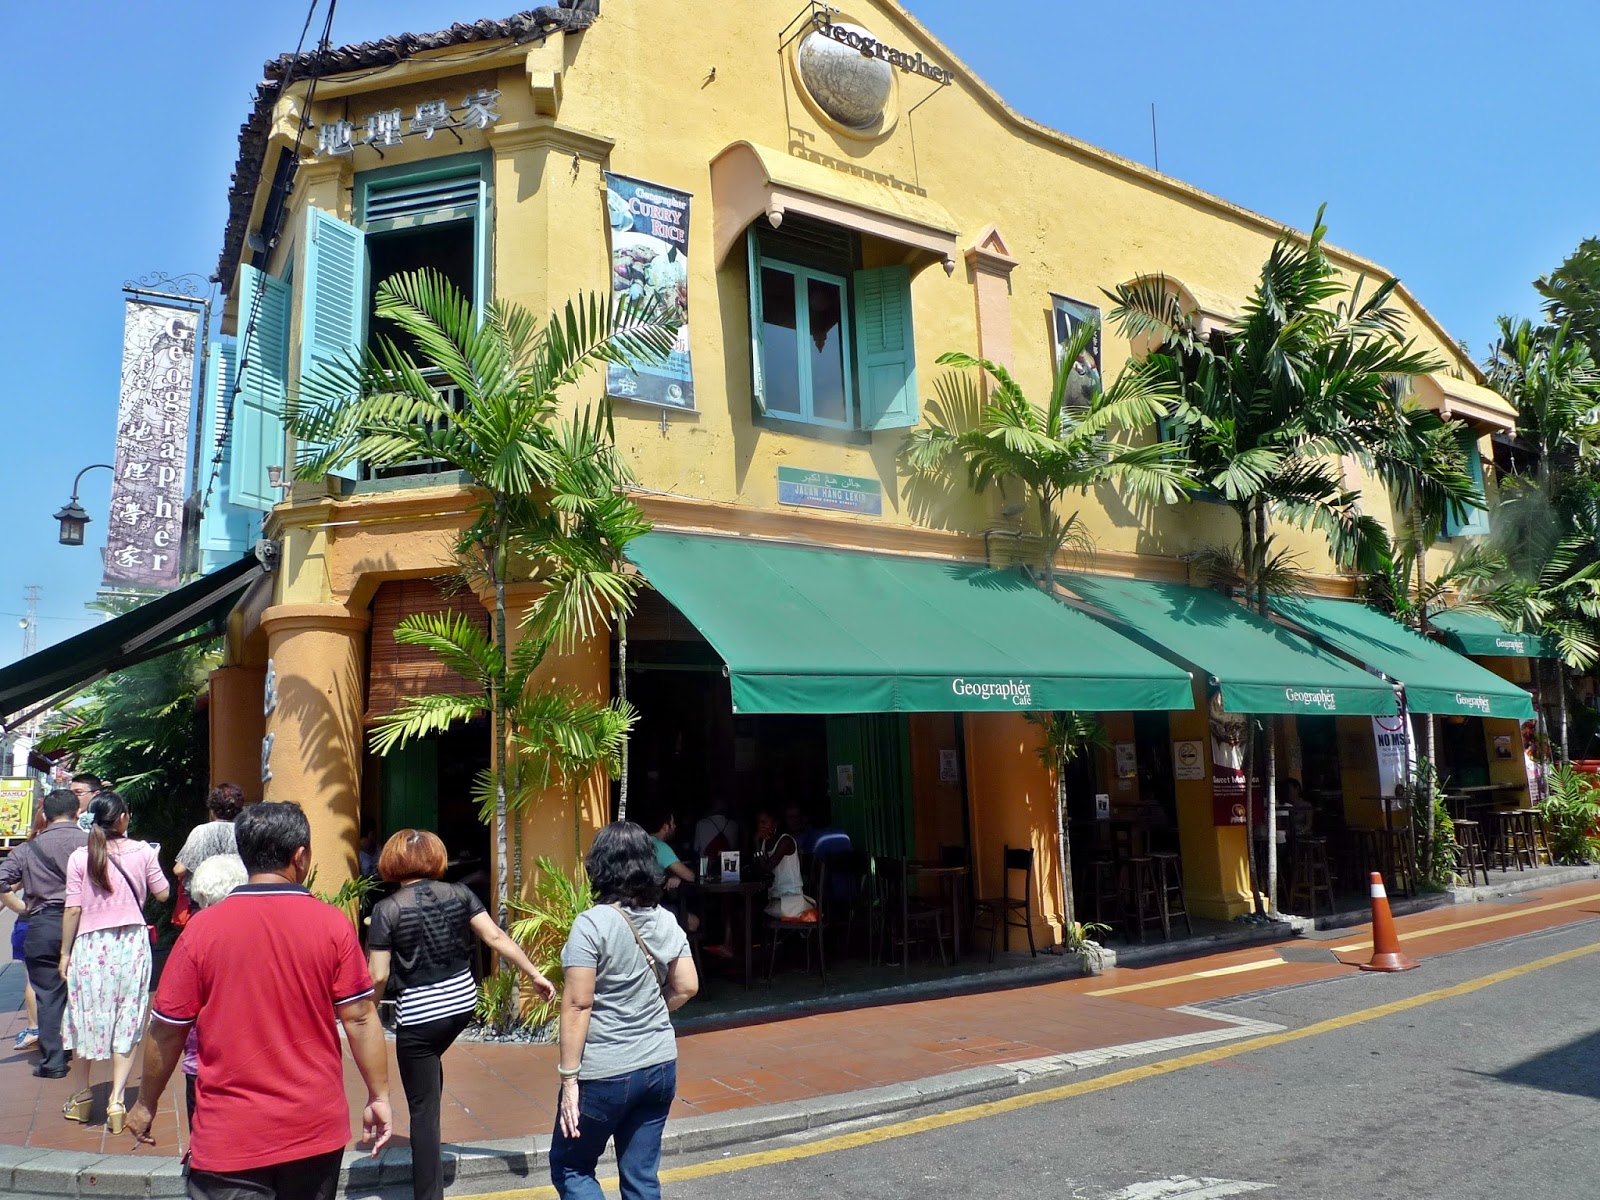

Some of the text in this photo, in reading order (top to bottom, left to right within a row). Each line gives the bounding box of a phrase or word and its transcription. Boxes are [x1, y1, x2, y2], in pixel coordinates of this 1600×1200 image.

[313, 88, 503, 157] 地理學家
[628, 197, 682, 225] CURRY
[651, 218, 685, 244] RICE
[795, 485, 866, 503] JALAN HANG LEKIR
[952, 678, 1031, 700] Geographér
[1012, 694, 1032, 706] Café
[1377, 734, 1390, 747] NO
